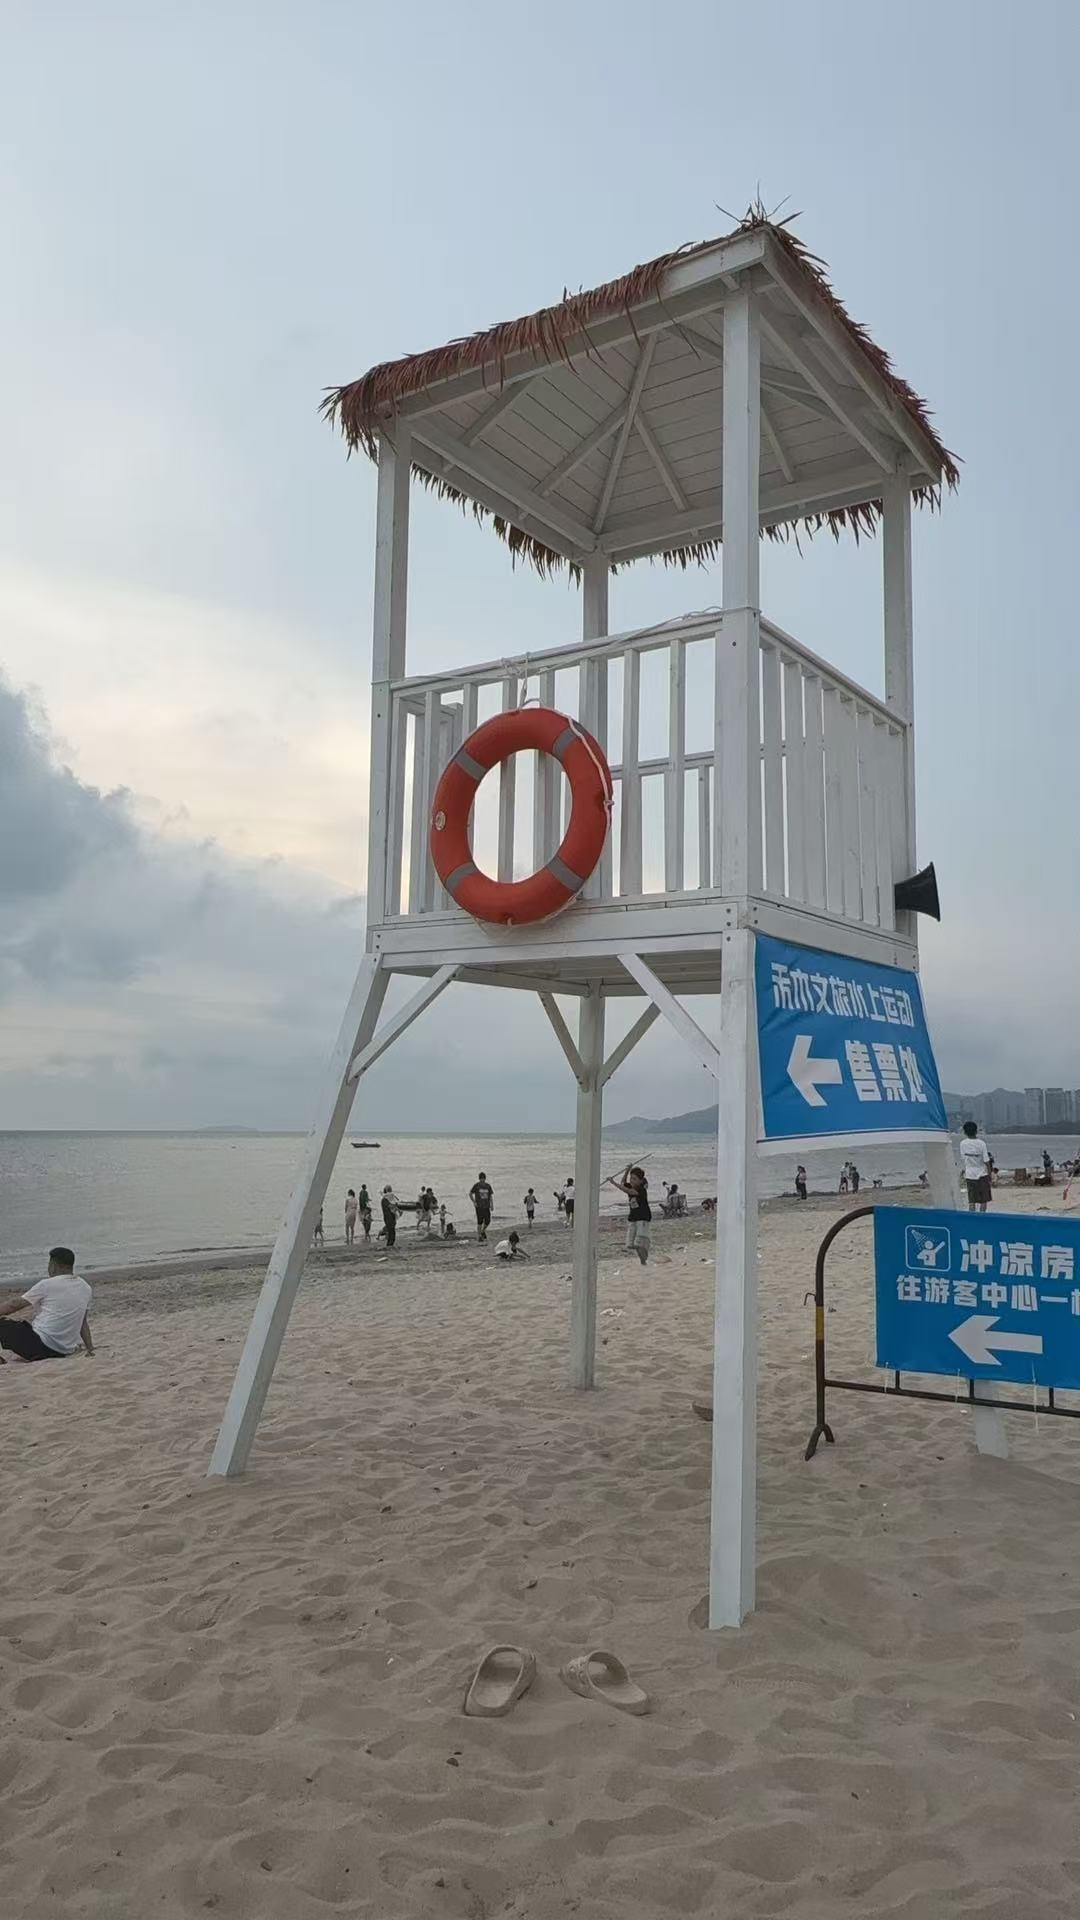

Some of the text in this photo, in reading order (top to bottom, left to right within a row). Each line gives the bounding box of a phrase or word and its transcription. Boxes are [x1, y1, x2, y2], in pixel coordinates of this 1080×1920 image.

[771, 962, 915, 1027] 禾木文旅水上运动
[845, 1040, 928, 1103] 售票处
[960, 1239, 1074, 1280] 冲凉房
